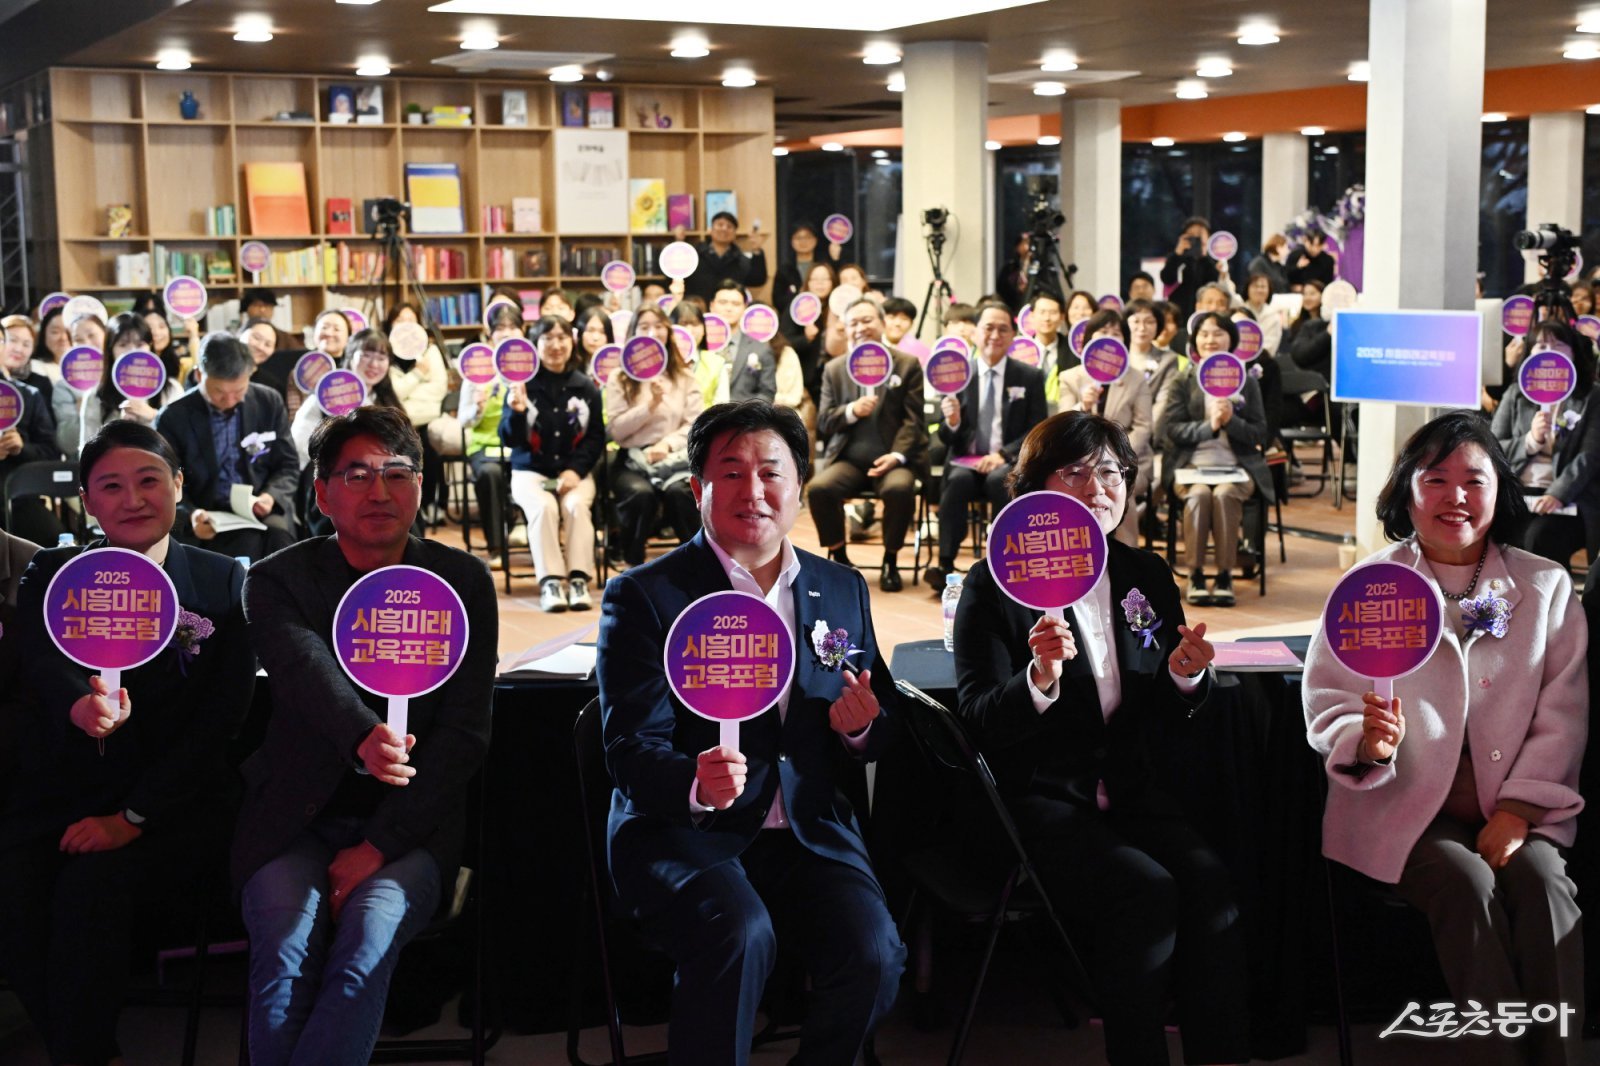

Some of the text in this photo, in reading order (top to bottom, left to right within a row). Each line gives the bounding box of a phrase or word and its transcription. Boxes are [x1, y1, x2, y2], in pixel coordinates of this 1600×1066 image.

[1027, 512, 1060, 527] 2025
[1003, 525, 1092, 556] 시흥미래
[94, 571, 130, 584] 2025
[1005, 553, 1095, 583] 교육포럼
[61, 588, 161, 613] 시흥미래
[384, 589, 421, 604] 2025
[1365, 582, 1398, 596] 2025
[351, 608, 452, 635] 시흥미래
[713, 615, 748, 630] 2025
[1338, 597, 1427, 624] 시흥미래
[61, 616, 160, 640] 교육포럼
[1338, 625, 1427, 651] 교육포럼
[350, 638, 450, 666] 교육포럼
[682, 633, 779, 659] 시흥미래
[682, 663, 778, 689] 교육포럼
